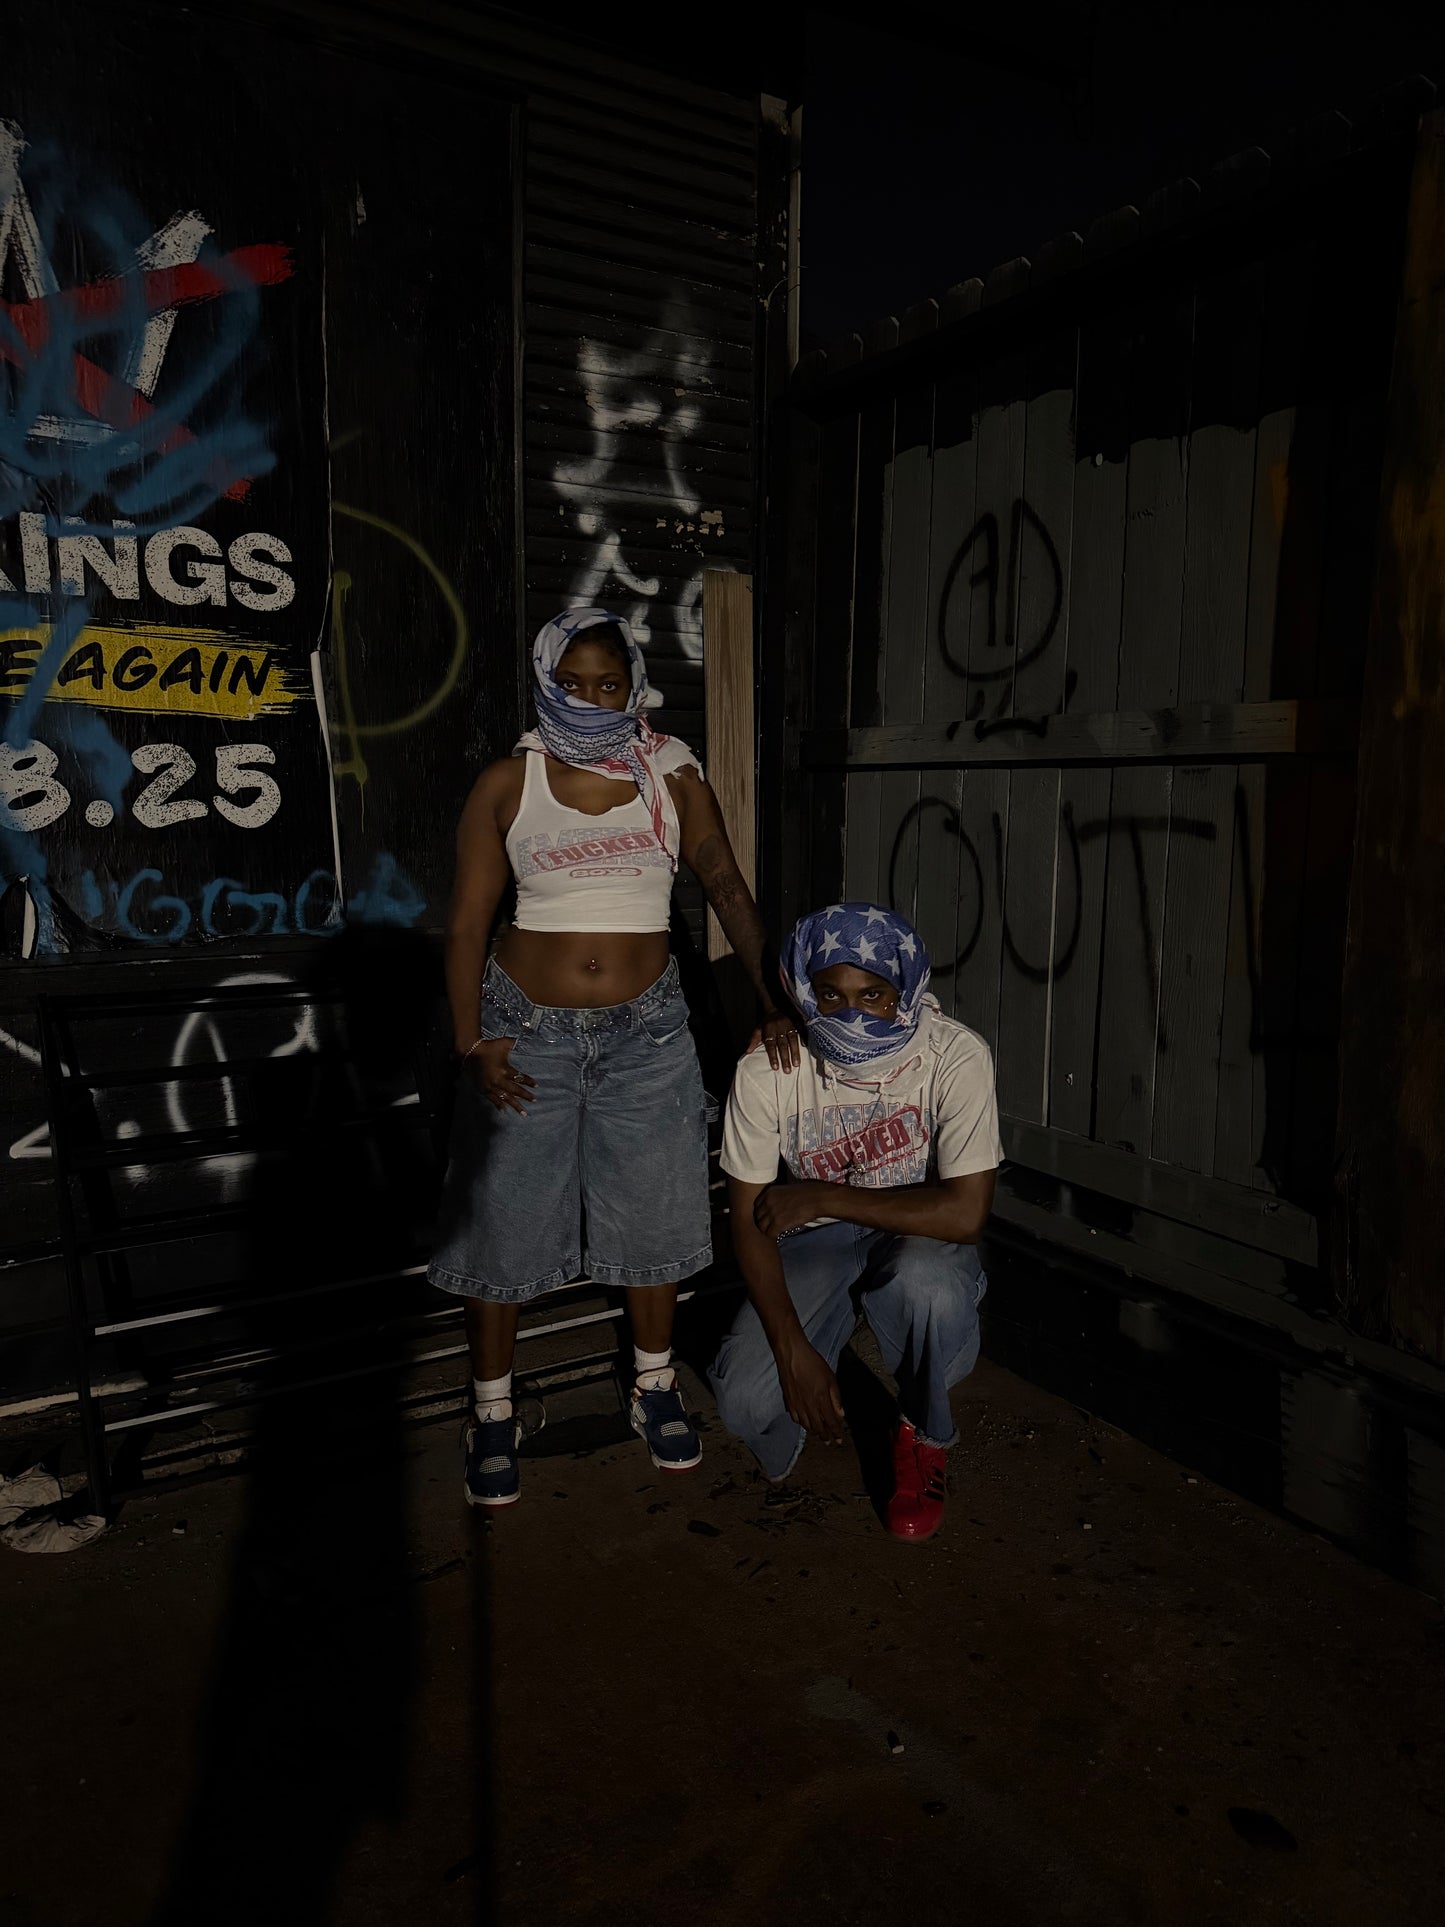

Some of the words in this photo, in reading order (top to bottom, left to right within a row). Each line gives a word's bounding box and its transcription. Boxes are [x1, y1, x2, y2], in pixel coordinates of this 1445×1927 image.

[0, 511, 296, 611] INGS
[57, 642, 272, 697] AGAIN
[547, 833, 656, 866] FUCKED
[811, 1116, 911, 1179] FUCKED
